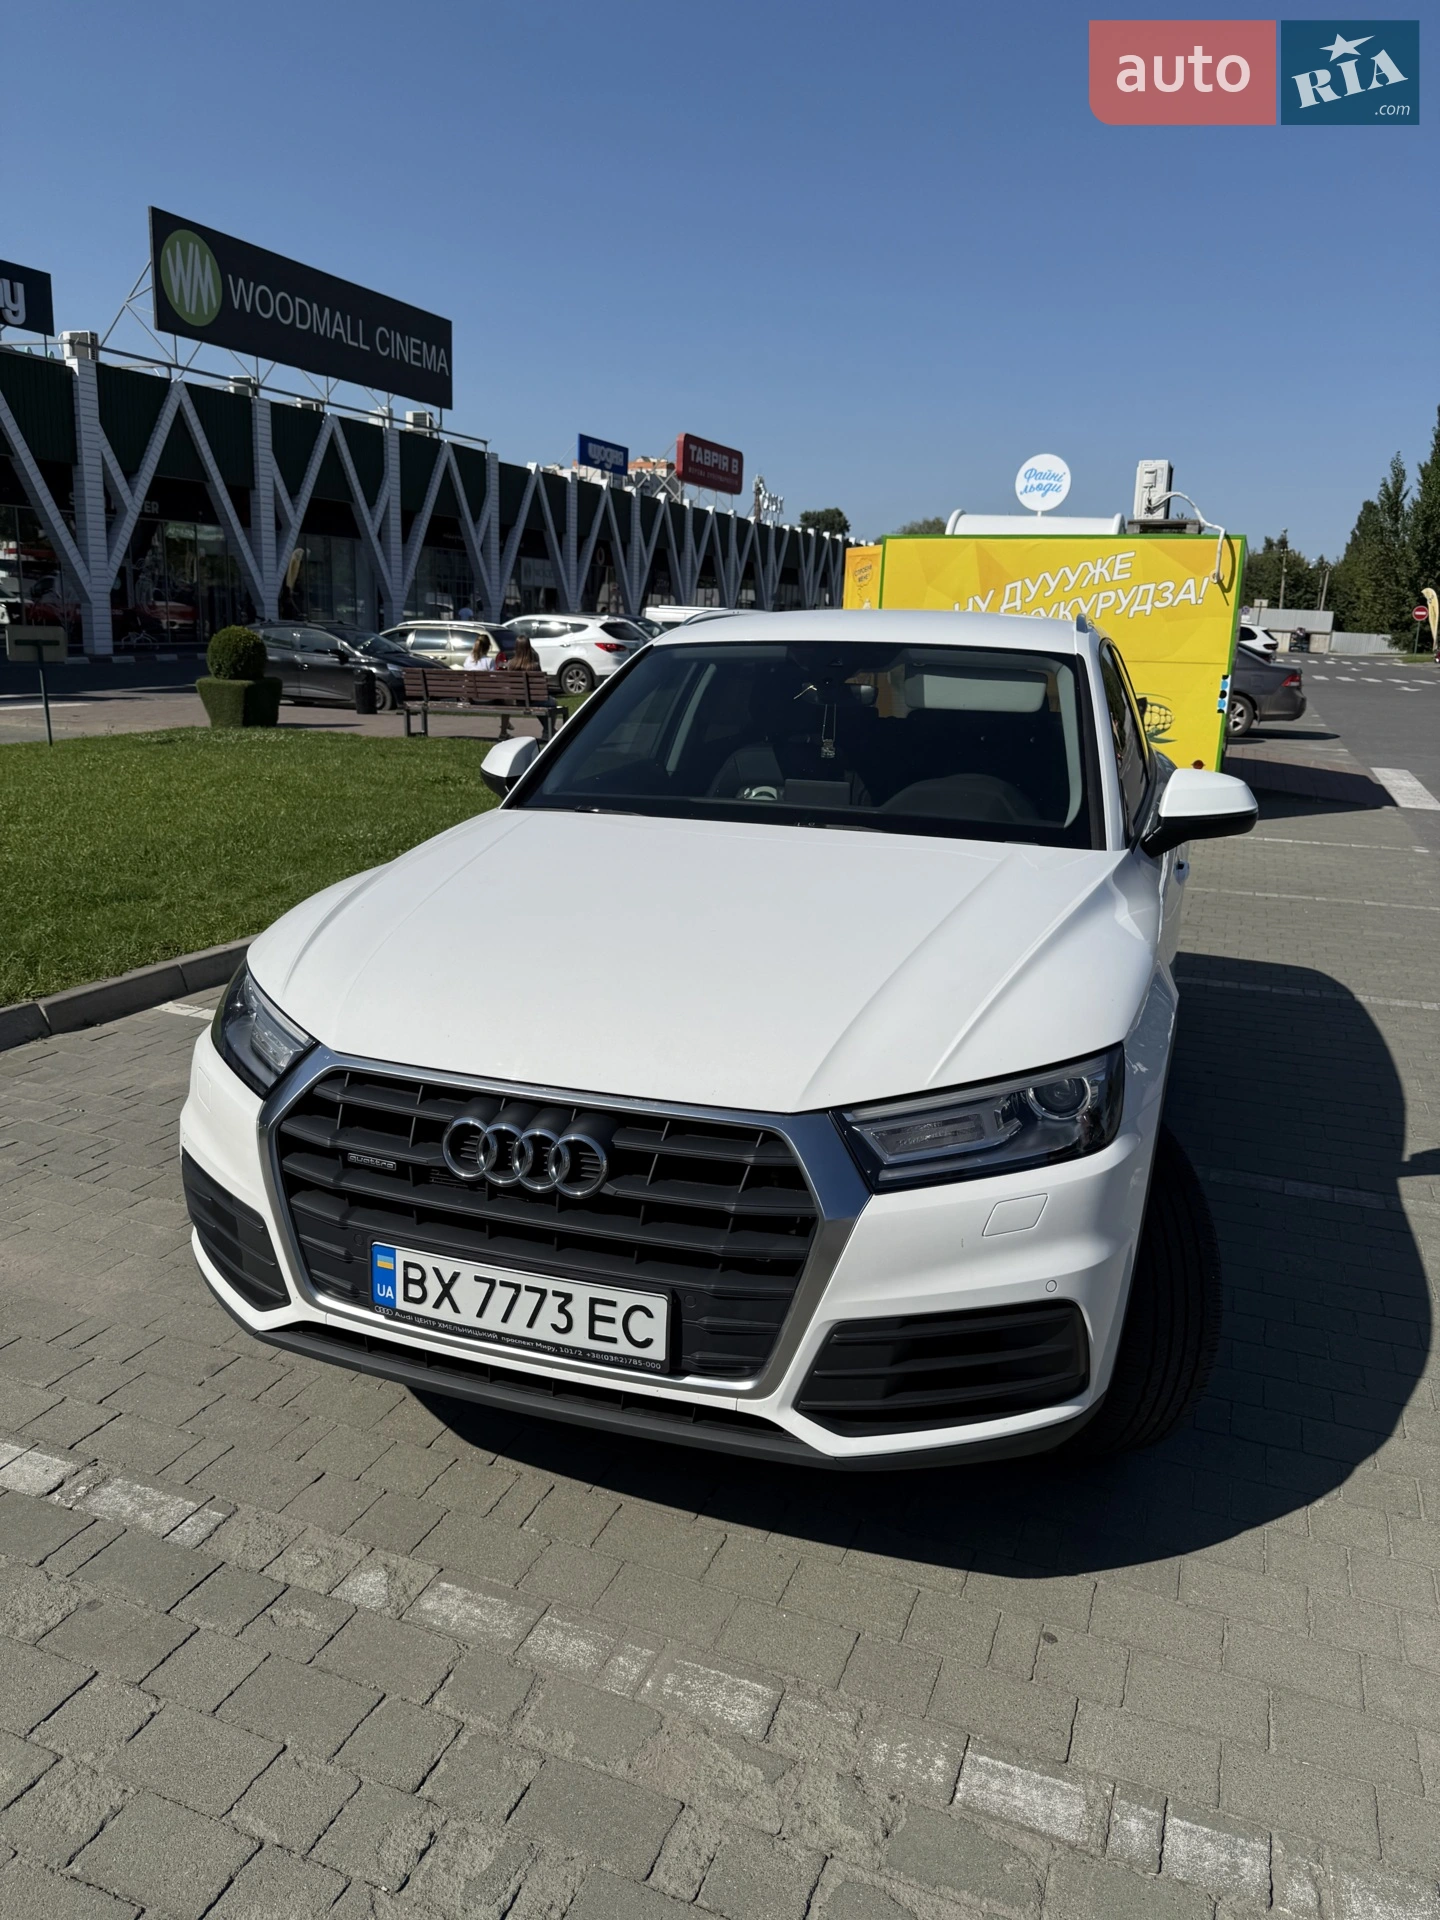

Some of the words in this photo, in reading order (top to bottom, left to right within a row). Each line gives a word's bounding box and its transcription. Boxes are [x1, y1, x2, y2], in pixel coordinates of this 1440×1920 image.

[228, 273, 370, 352] WOODMALL
[375, 326, 450, 377] CINEMA
[689, 444, 730, 473] ТАВРІЯ
[730, 458, 739, 475] В
[1024, 468, 1066, 483] Файні
[1020, 482, 1062, 498] льоди
[999, 551, 1136, 613] ДУУУЖЕ
[1022, 577, 1209, 619] УКУРУДЗА!
[349, 1155, 394, 1169] quattro
[377, 1283, 394, 1300] UA
[403, 1260, 461, 1314] BX
[474, 1275, 573, 1335] 7773
[588, 1296, 655, 1349] EC
[394, 1311, 414, 1321] Audi
[414, 1316, 437, 1327] ЦЕНТР
[438, 1322, 498, 1340] ХМЕЛЬНИЦЬКИЙ
[501, 1336, 535, 1348] проспект
[559, 1346, 583, 1357] 101/2
